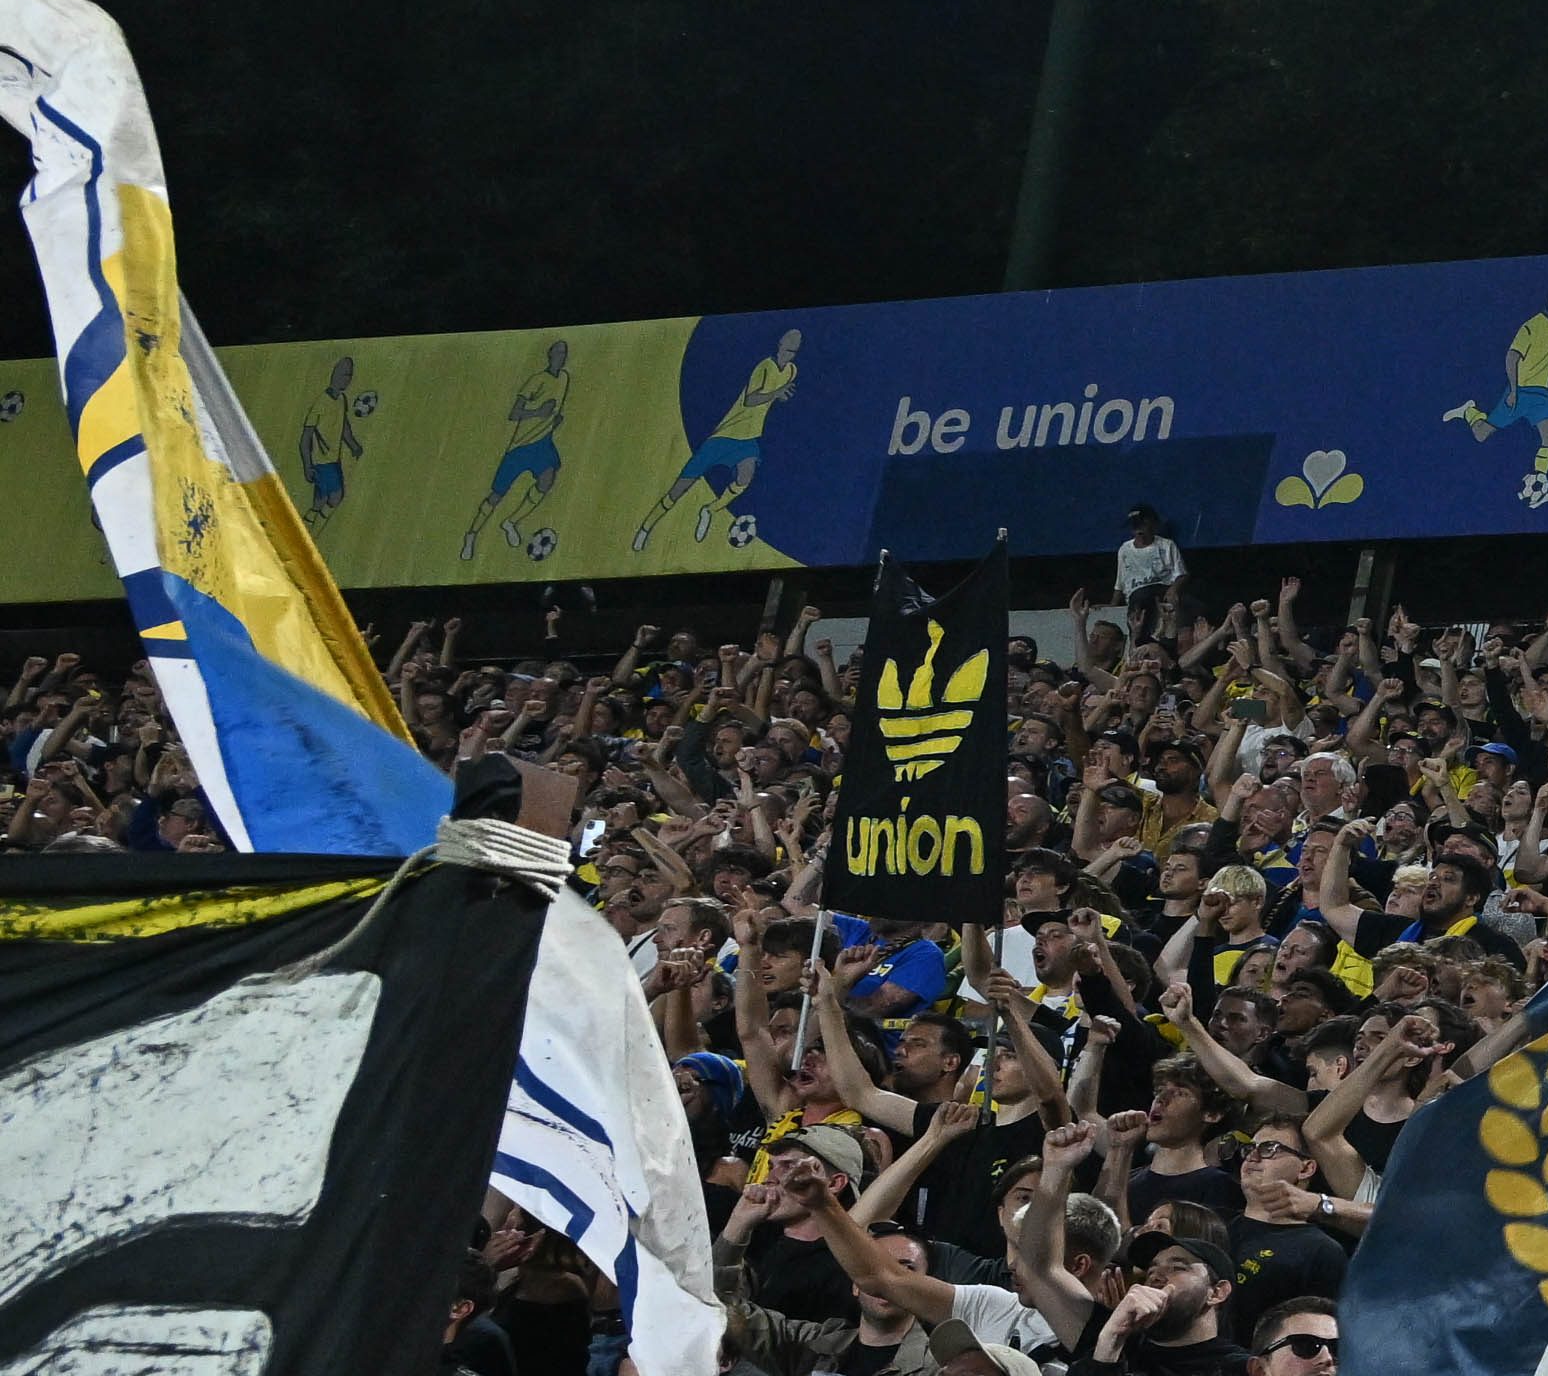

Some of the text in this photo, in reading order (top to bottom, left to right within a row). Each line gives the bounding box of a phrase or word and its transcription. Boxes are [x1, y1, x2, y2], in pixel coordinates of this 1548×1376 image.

[888, 383, 1176, 456] be union
[846, 796, 984, 876] union
